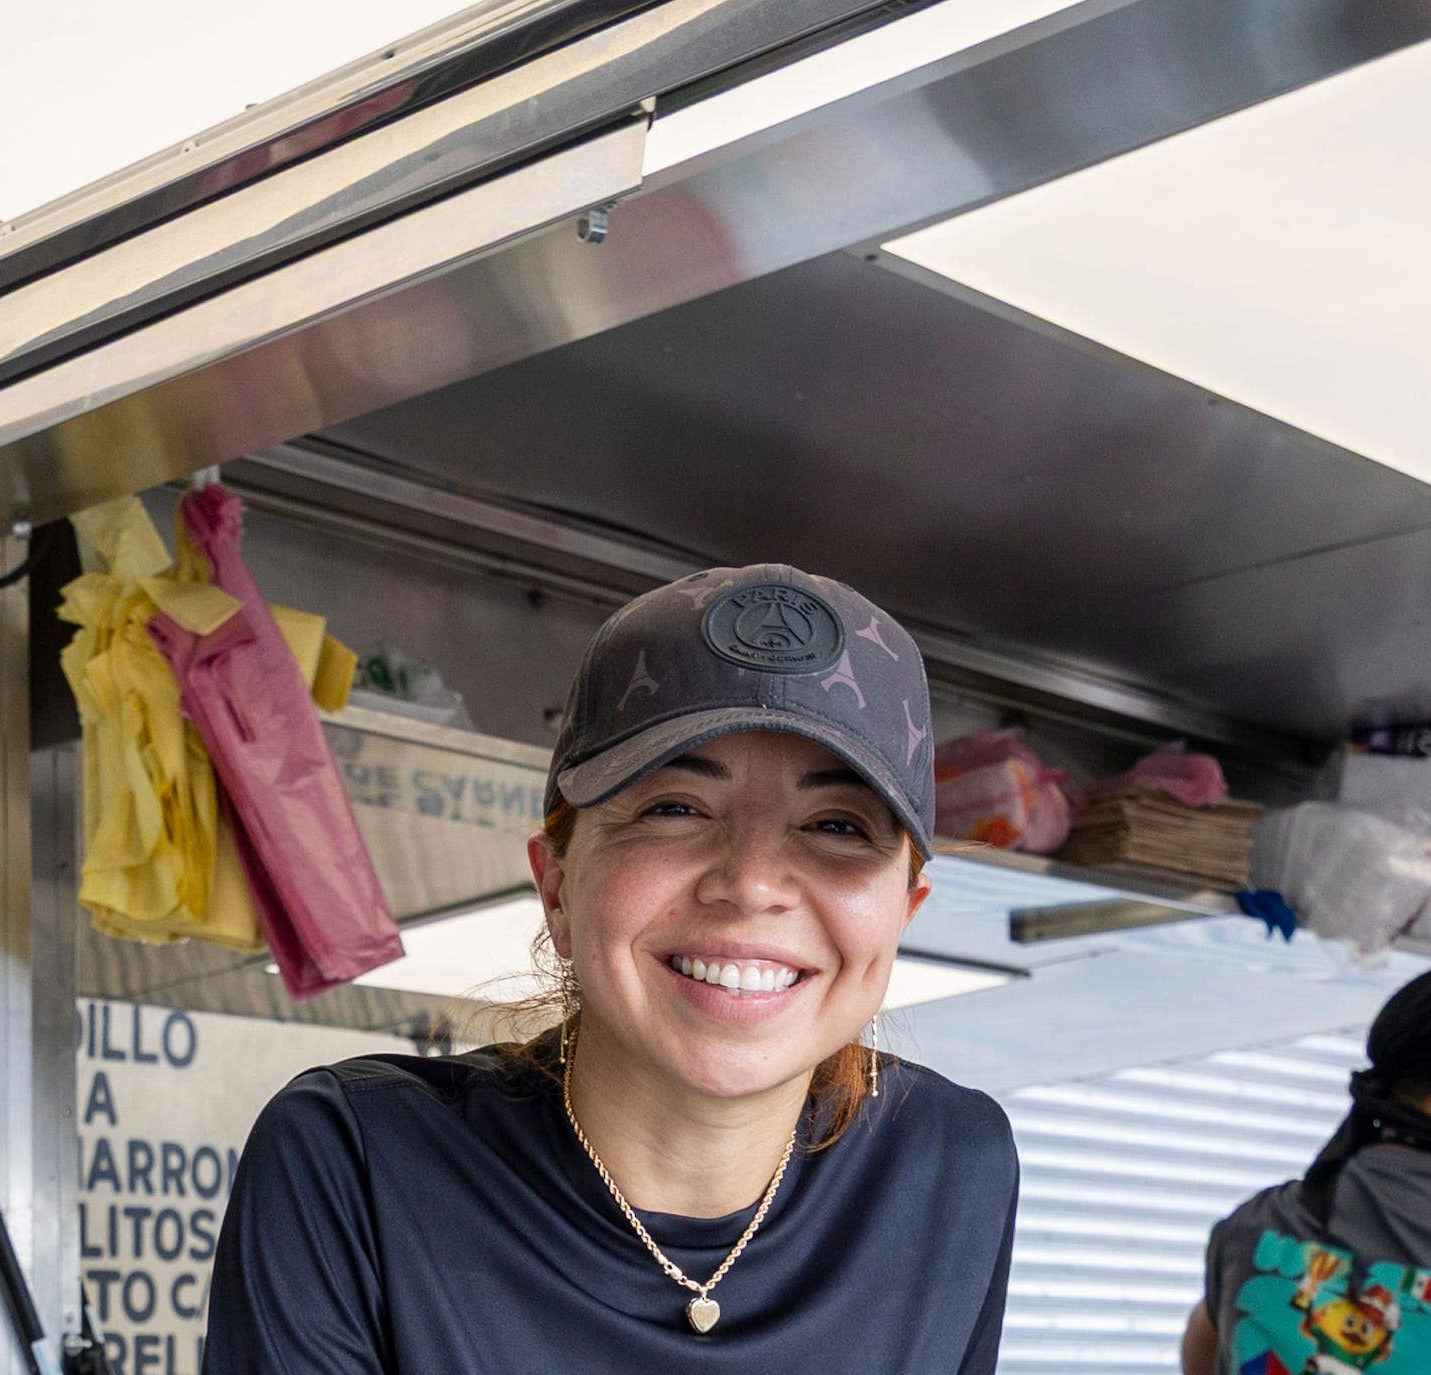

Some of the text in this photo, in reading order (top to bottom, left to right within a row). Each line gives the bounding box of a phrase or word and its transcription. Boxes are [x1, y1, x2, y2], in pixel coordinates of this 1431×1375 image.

[730, 588, 818, 616] PARIS
[76, 1003, 197, 1069] ILLO
[76, 1136, 238, 1202] ARRO
[78, 1202, 217, 1262] LITOS
